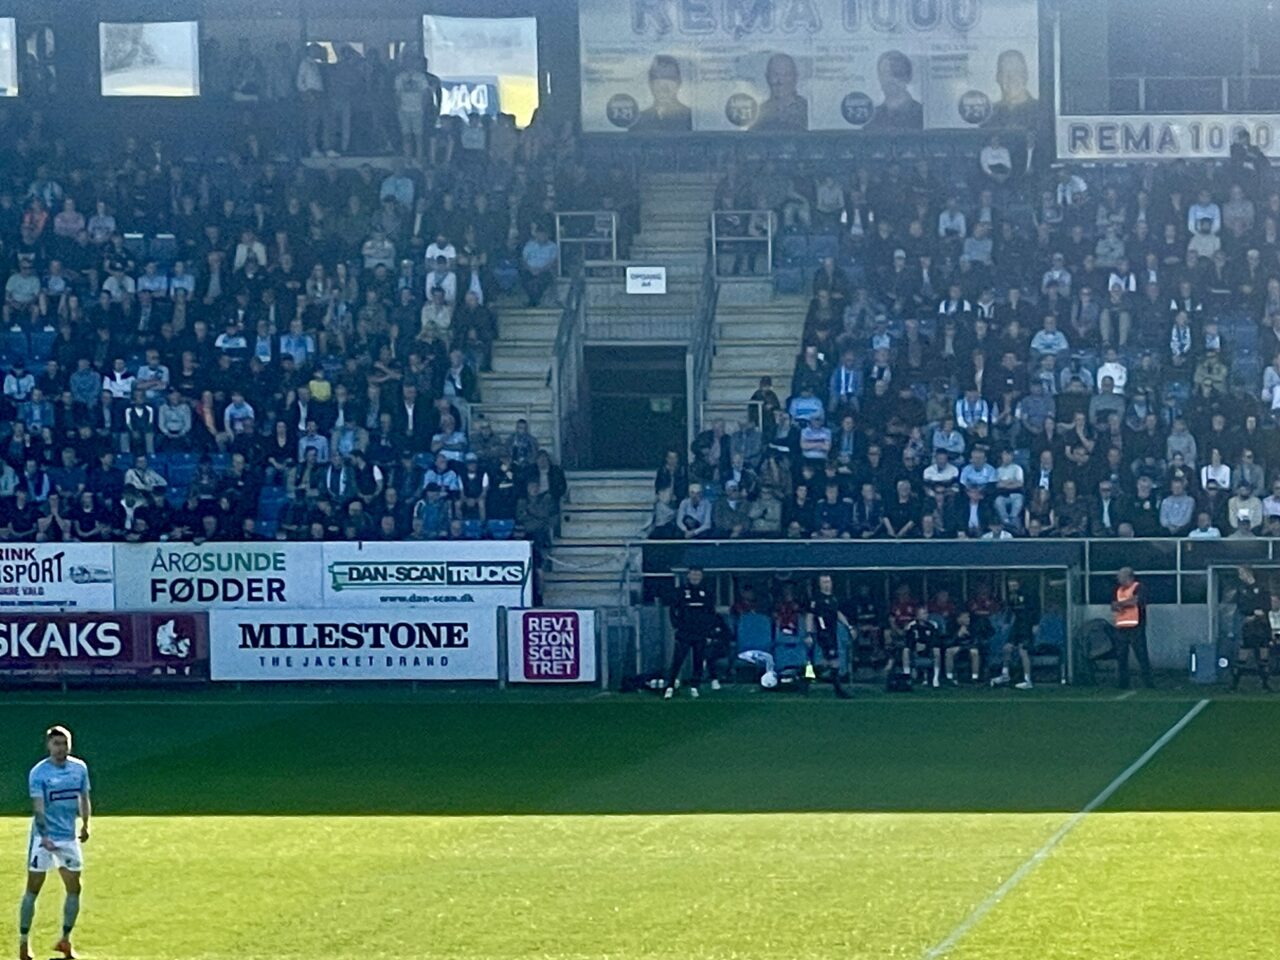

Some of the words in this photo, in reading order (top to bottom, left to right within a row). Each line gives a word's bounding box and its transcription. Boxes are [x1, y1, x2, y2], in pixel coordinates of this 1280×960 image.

[1068, 122, 1180, 154] REMA
[0, 551, 65, 584] SPORT
[150, 547, 286, 573] ÅRØSUNDE
[348, 565, 446, 582] DAN-SCAN
[448, 565, 524, 583] TRUCKS
[150, 576, 287, 604] FØDDER
[528, 617, 574, 631] REVI
[238, 623, 469, 649] MILESTONE
[528, 631, 574, 645] SION
[528, 645, 574, 660] SCEN
[259, 656, 293, 668] THE
[302, 656, 374, 668] JACKET
[385, 656, 449, 668] BRAND
[528, 660, 574, 675] TRET
